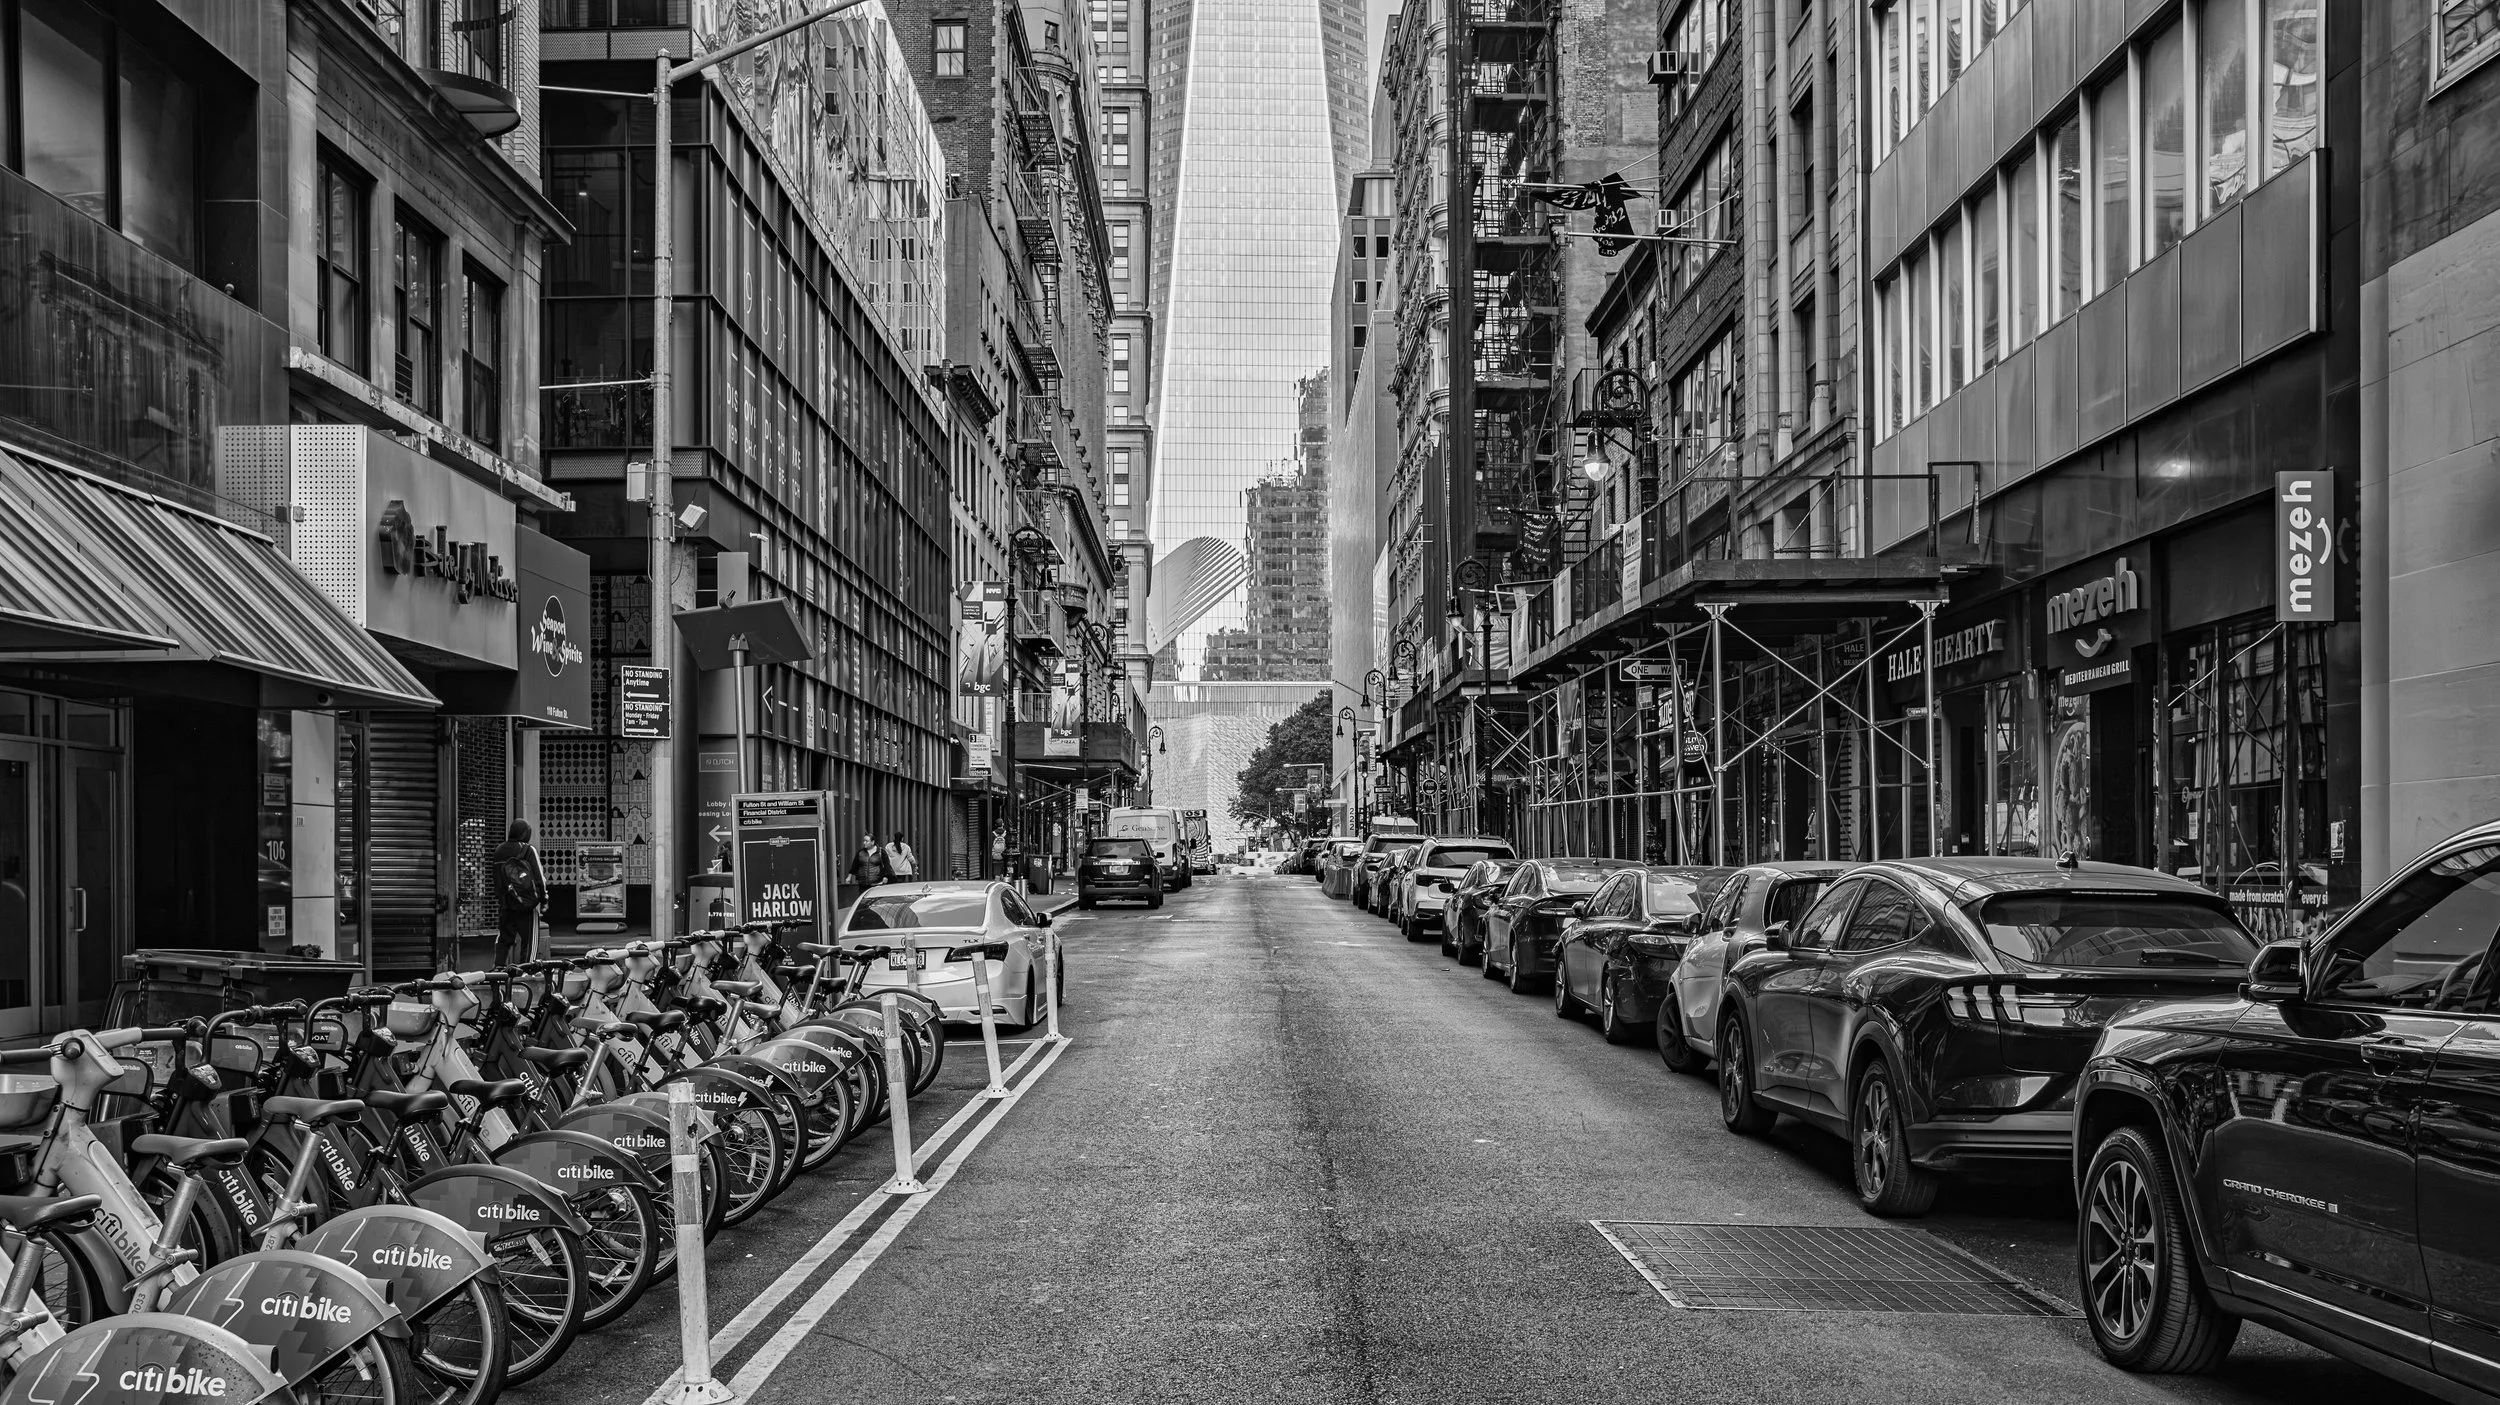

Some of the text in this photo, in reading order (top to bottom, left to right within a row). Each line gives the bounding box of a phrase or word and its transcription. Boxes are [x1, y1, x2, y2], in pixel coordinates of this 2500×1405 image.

[2282, 481, 2312, 613] mezeh
[2047, 557, 2137, 635] mezeh
[540, 609, 566, 639] Seaport
[531, 625, 553, 654] Wine
[559, 639, 583, 665] Spirits
[1844, 643, 1865, 653] HALE
[1888, 619, 1998, 682] HALE HEARTY
[625, 670, 663, 679] NO STANDING
[1631, 665, 1649, 674] ONE
[2064, 660, 2130, 686] MEDITERRANEAN GRILL
[625, 678, 650, 687] Anytime
[973, 682, 991, 693] bgc
[625, 703, 663, 712] NO STANDING
[625, 712, 660, 720] Monday Friday
[1060, 729, 1072, 737] bgc
[706, 801, 727, 809] Lobby
[698, 810, 720, 818] easing
[266, 840, 286, 861] 106
[762, 882, 800, 901] JACK
[2229, 889, 2284, 903] made from scratch
[752, 896, 813, 918] HARLOW
[2223, 1178, 2326, 1210] GRAND CHEROKEE
